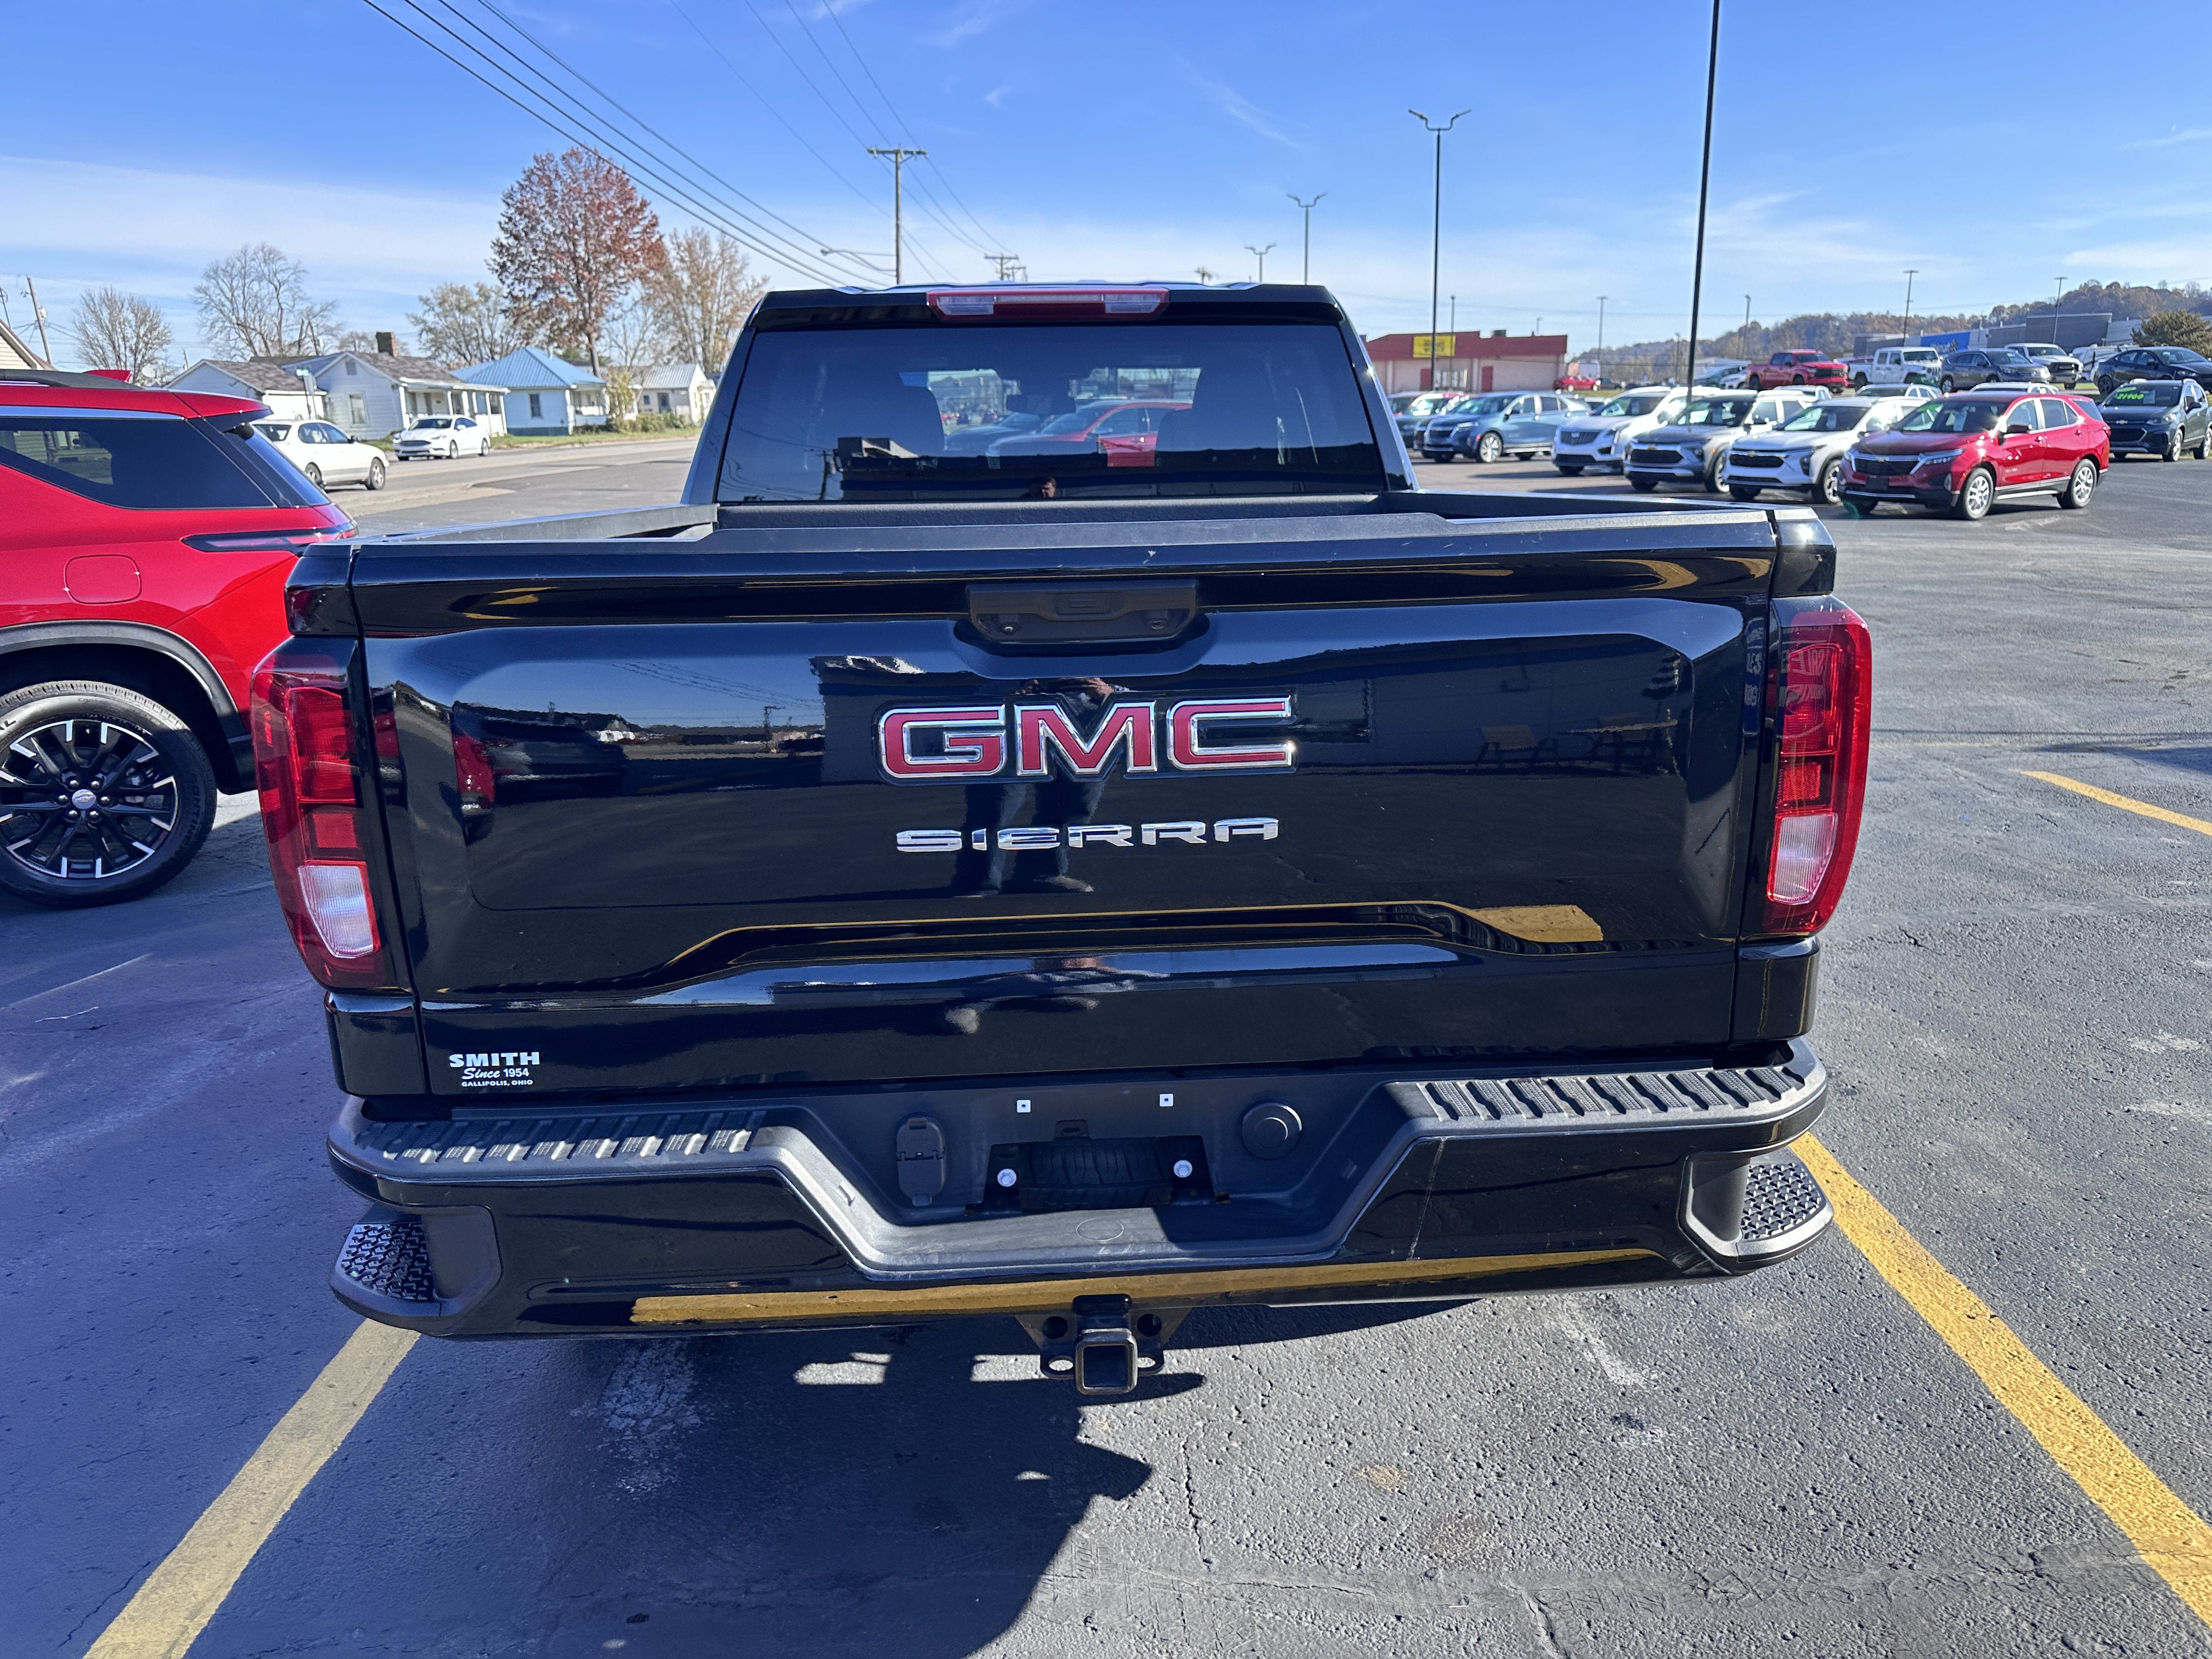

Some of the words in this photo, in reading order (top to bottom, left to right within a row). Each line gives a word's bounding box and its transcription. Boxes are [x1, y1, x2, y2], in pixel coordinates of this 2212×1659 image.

[879, 696, 1293, 778] GMC
[896, 817, 1279, 852] SIERRA
[449, 1052, 540, 1068] SMITH
[461, 1068, 500, 1080] Since
[503, 1068, 529, 1077] 1954
